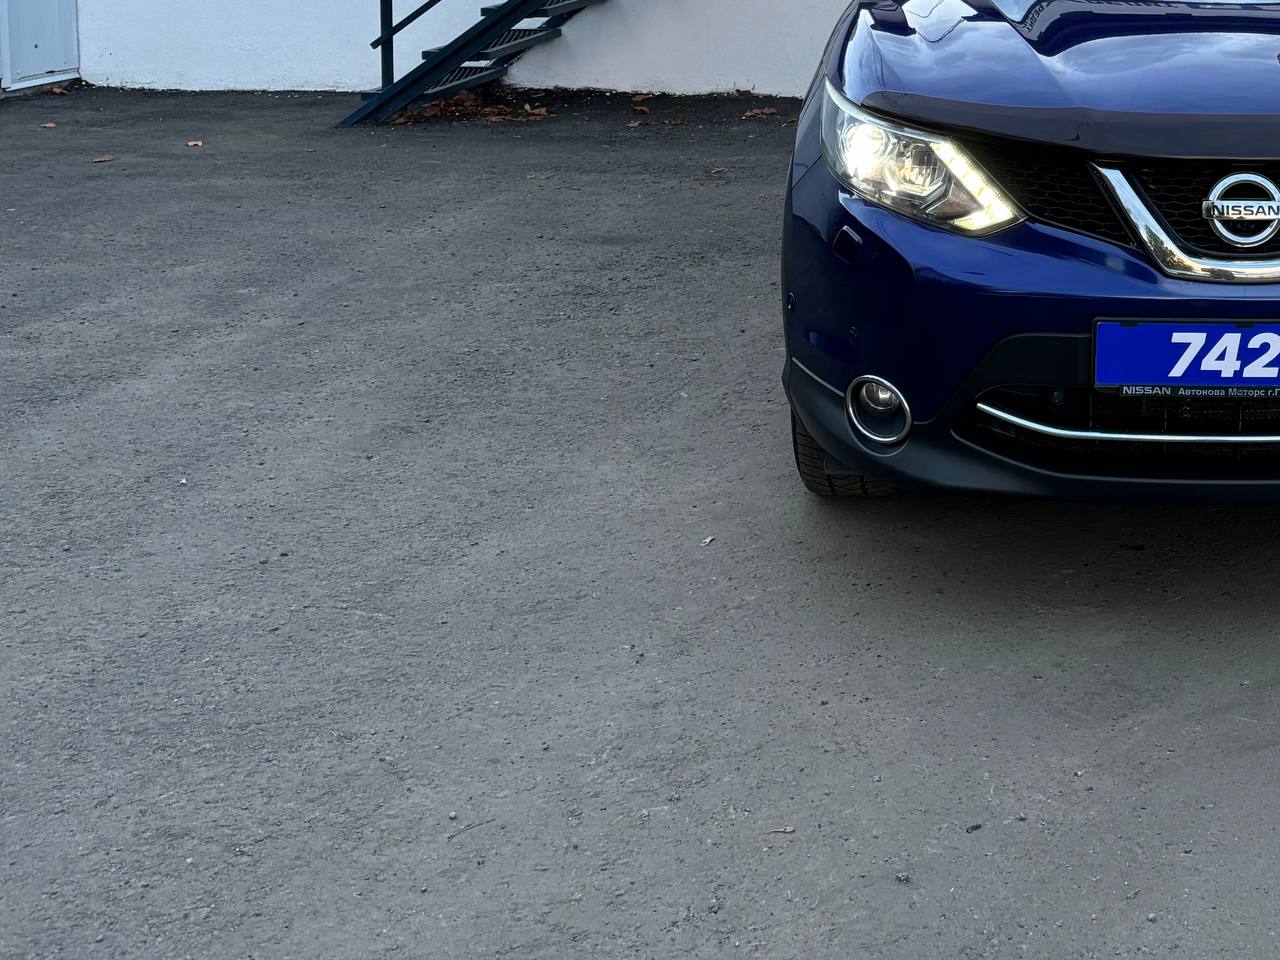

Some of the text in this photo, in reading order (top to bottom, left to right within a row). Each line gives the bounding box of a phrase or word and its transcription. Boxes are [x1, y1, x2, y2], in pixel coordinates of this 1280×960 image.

[1210, 204, 1280, 217] NISSAN
[1122, 386, 1171, 395] NISSAN
[1178, 388, 1225, 396] Автонова
[1228, 388, 1265, 397] Моторс
